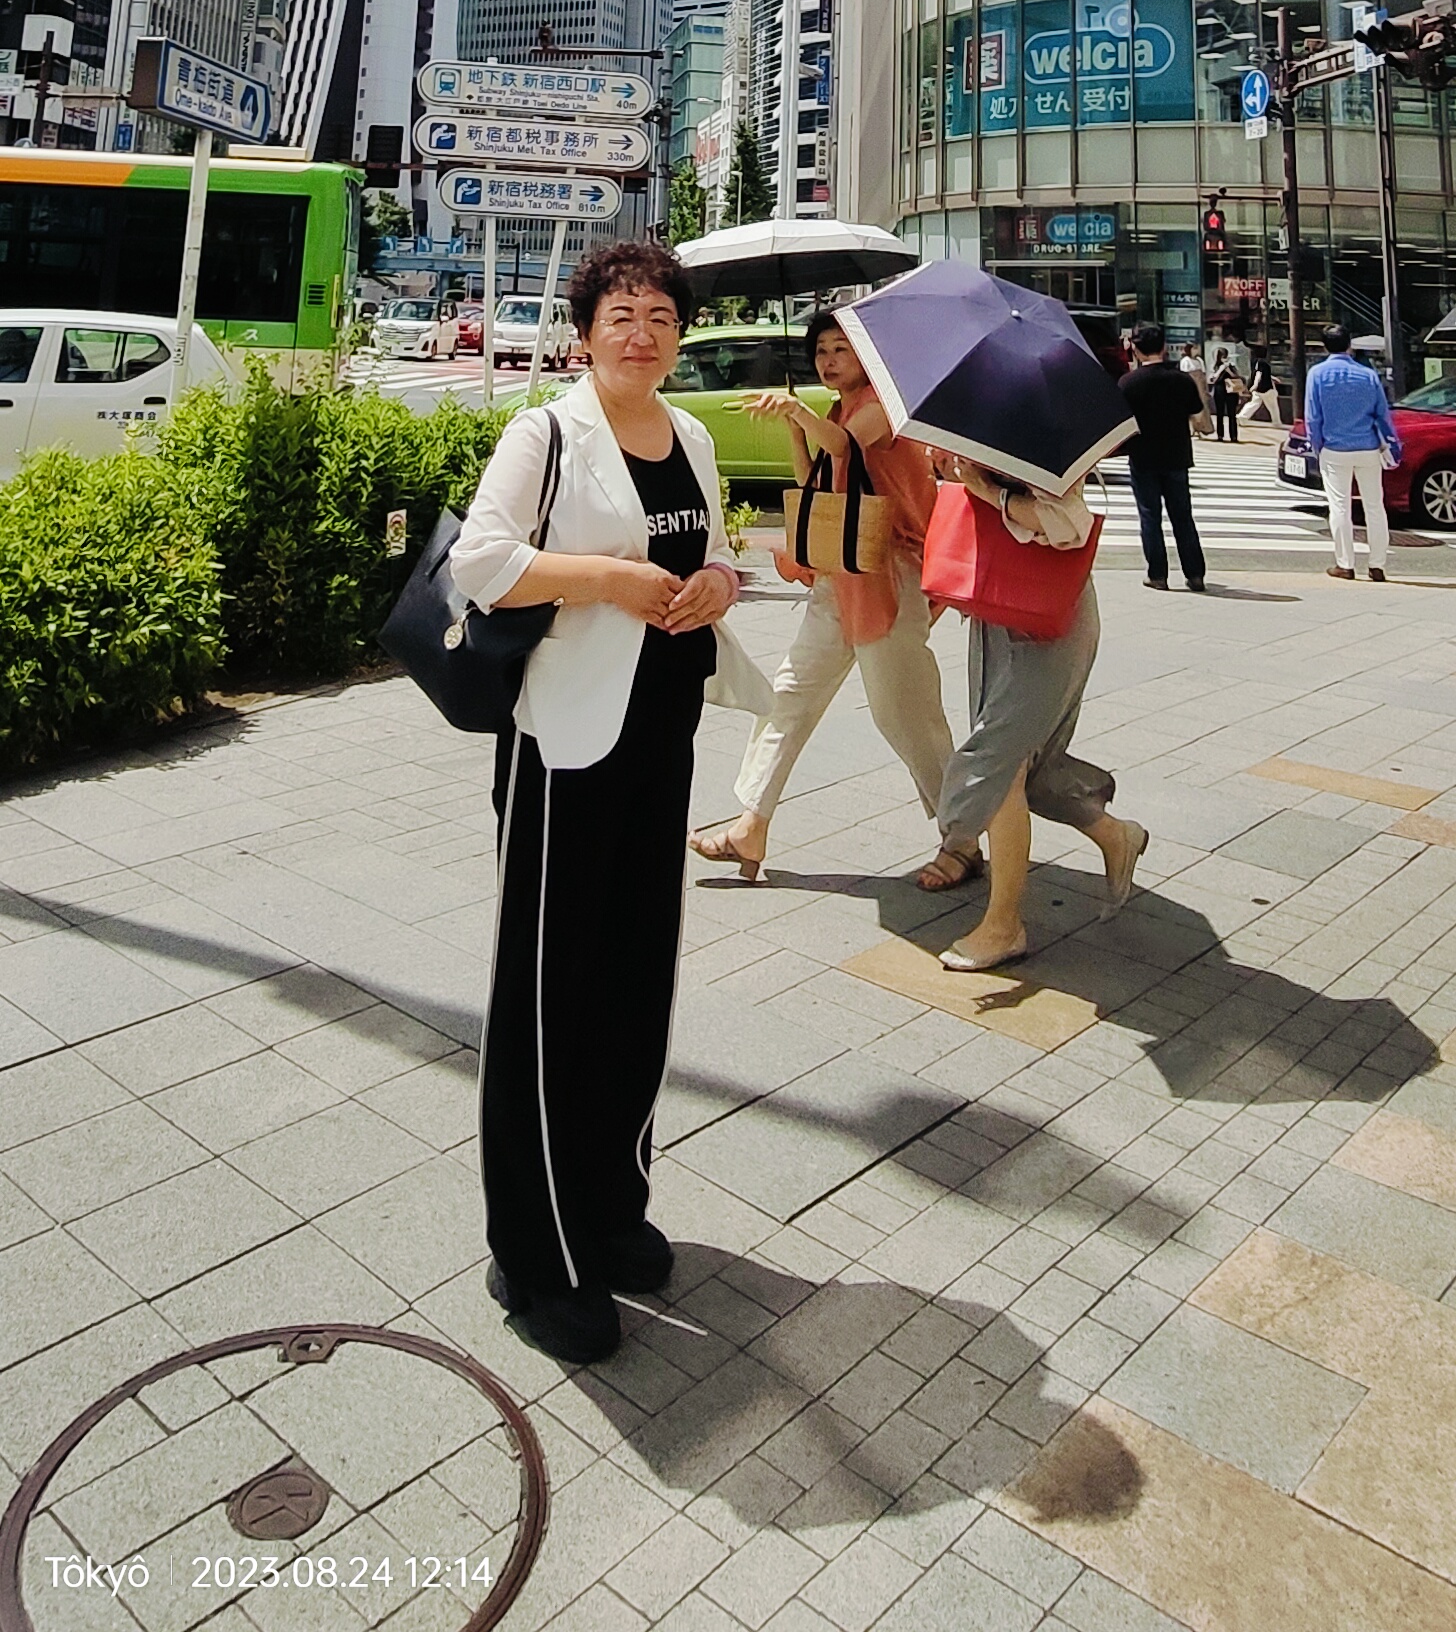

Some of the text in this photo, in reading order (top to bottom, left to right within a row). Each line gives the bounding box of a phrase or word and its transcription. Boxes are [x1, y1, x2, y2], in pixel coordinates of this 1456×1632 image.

[1030, 24, 1154, 75] welcia
[467, 69, 606, 94] 地下鉄 新宿西口駅
[616, 100, 638, 110] 40m
[466, 125, 600, 149] 新宿都税事務所
[474, 142, 514, 154] Shinjuku
[541, 146, 556, 156] Tax
[560, 148, 587, 158] Office
[607, 152, 634, 162] 330m
[488, 180, 572, 200] 新宿税務署
[488, 198, 570, 211] Shinjuku Tax Office
[578, 204, 605, 213] 810m
[1054, 216, 1112, 236] wecia
